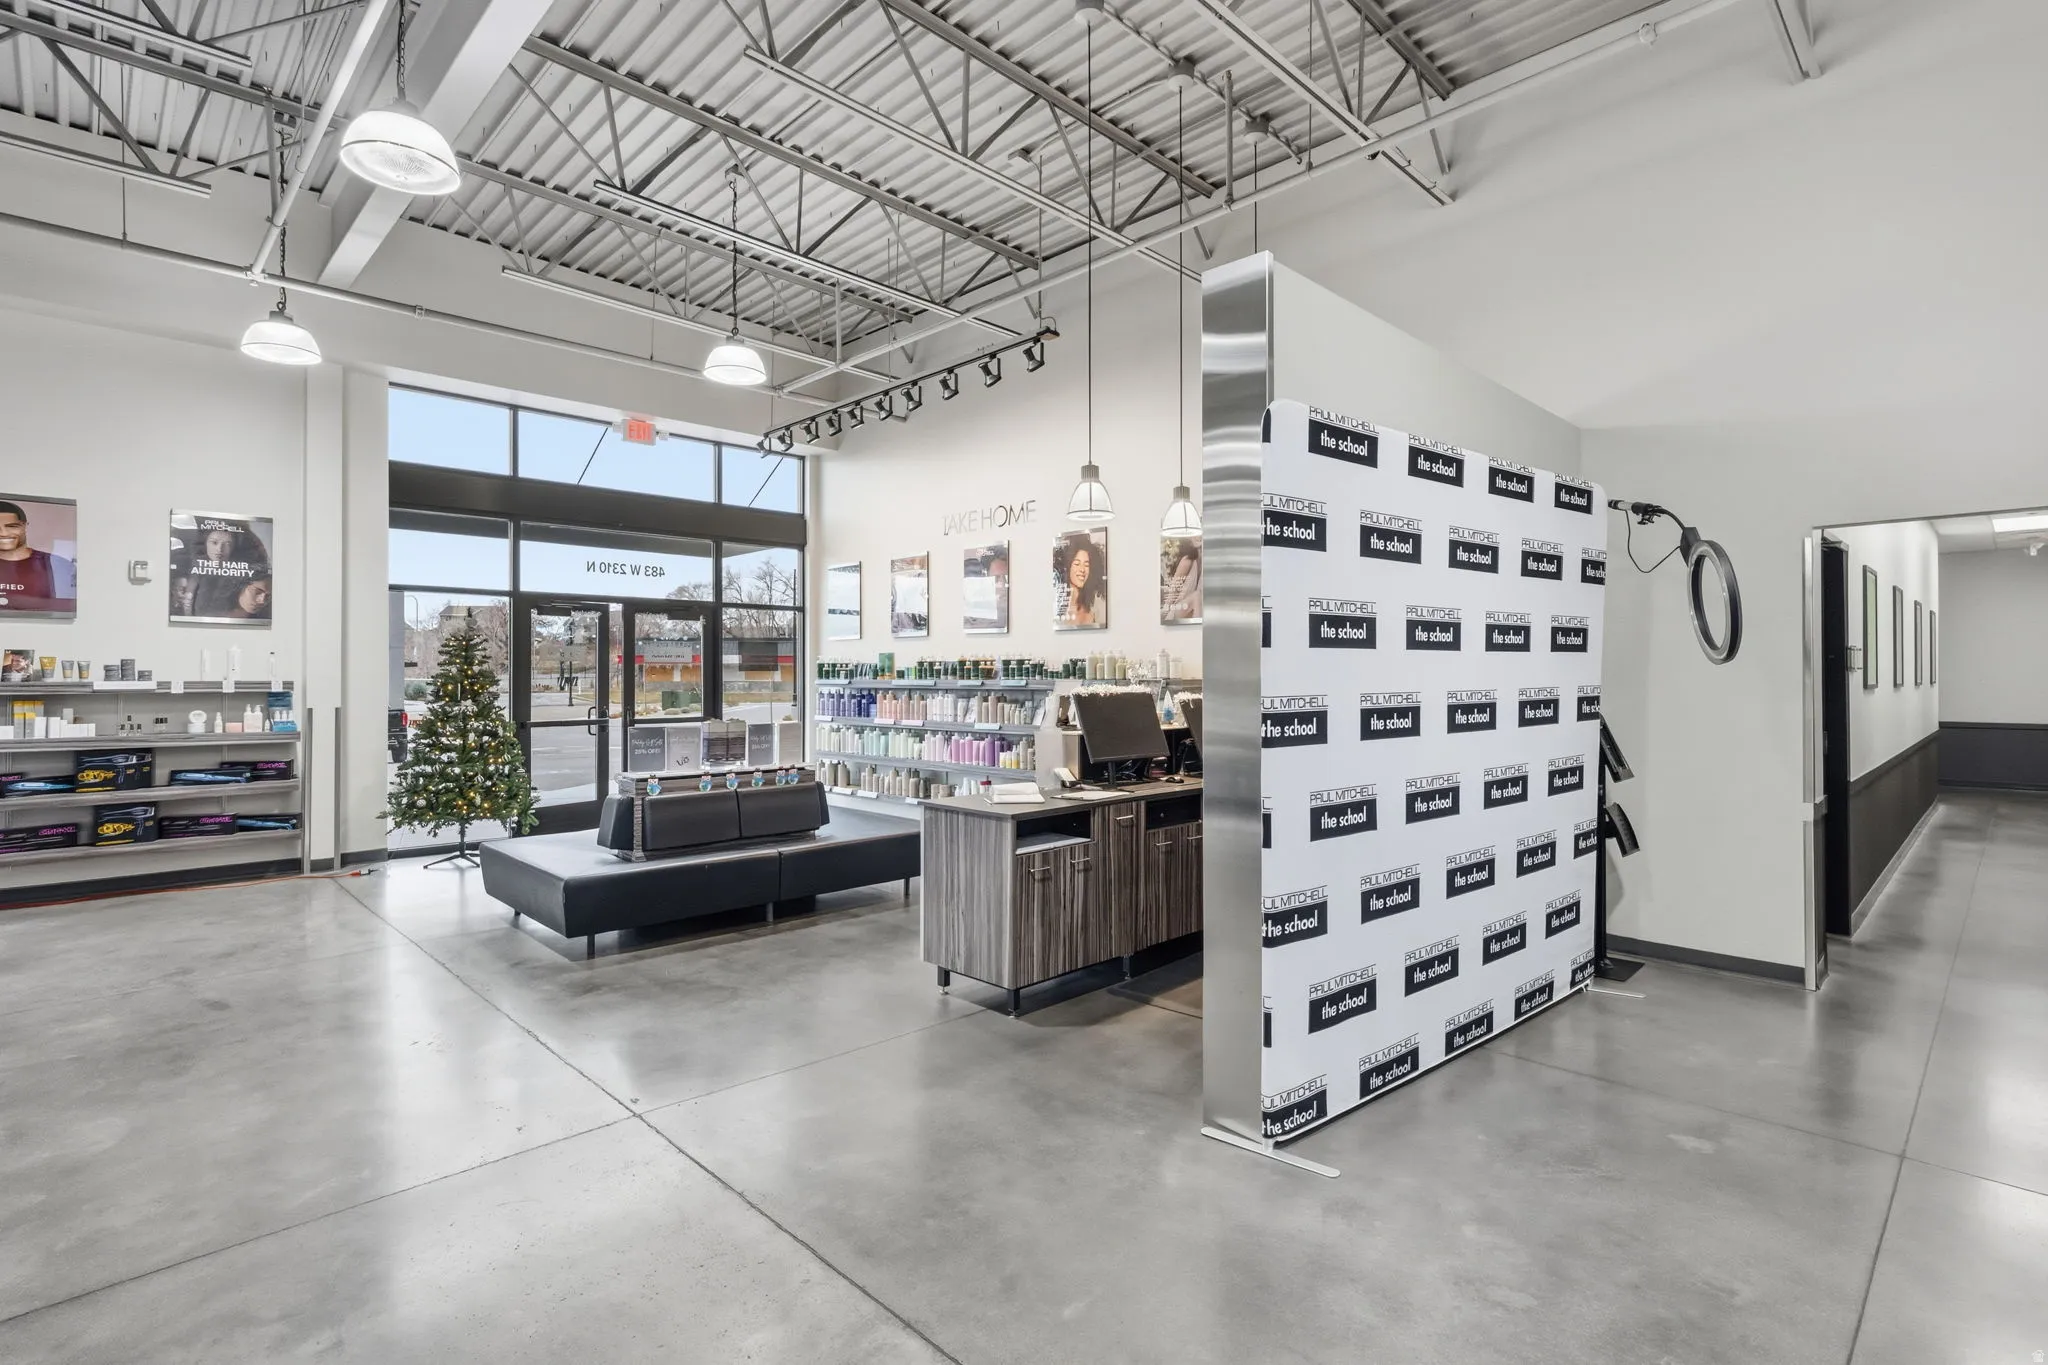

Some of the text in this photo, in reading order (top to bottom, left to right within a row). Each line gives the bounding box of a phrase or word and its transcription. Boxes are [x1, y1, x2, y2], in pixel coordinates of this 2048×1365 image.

[1309, 405, 1377, 434] PAUL MITCHELL
[1321, 430, 1367, 456] the school
[1418, 455, 1455, 477] the school
[1496, 474, 1527, 493] the school
[1279, 497, 1327, 515] MITCHELL
[942, 500, 1036, 535] TAKE HOME
[1360, 511, 1421, 532] PAUL MITCHELL
[201, 524, 244, 533] MITCHELL
[1261, 517, 1315, 540] the school
[1371, 533, 1412, 553] the school
[197, 559, 249, 569] THE HAIR
[1457, 546, 1491, 564] the school
[190, 566, 254, 577] AUTHORITY
[1309, 599, 1376, 615] PAUL MITCHELL
[1321, 621, 1366, 639] the school
[1416, 626, 1453, 642] the school
[1493, 630, 1524, 644] the school
[1280, 697, 1328, 709] MITCHELL
[1361, 694, 1420, 706] PAUL MITCHELL
[1371, 712, 1411, 730] the school
[1456, 708, 1489, 724] the school
[1261, 717, 1316, 737] the school
[1310, 786, 1377, 805] PAUL MITCHELL
[1492, 781, 1522, 799] the school
[1415, 792, 1452, 813] the school
[1322, 806, 1366, 829] the school
[1361, 866, 1419, 889] PAUL MITCHELL
[1455, 865, 1488, 887] the school
[1281, 888, 1328, 907] MITCHELL
[1370, 885, 1411, 911] the school
[1262, 910, 1317, 937] the school
[1491, 930, 1520, 953] the school
[1414, 956, 1451, 983] the school
[1309, 967, 1377, 998] PAUL MITCHELL
[1322, 988, 1366, 1019] the school
[1454, 1019, 1486, 1047] the school
[1360, 1037, 1419, 1071] PAUL MITCHELL
[1370, 1057, 1410, 1089] the school
[1280, 1078, 1327, 1105] MITCHELL
[1261, 1100, 1317, 1135] the school
